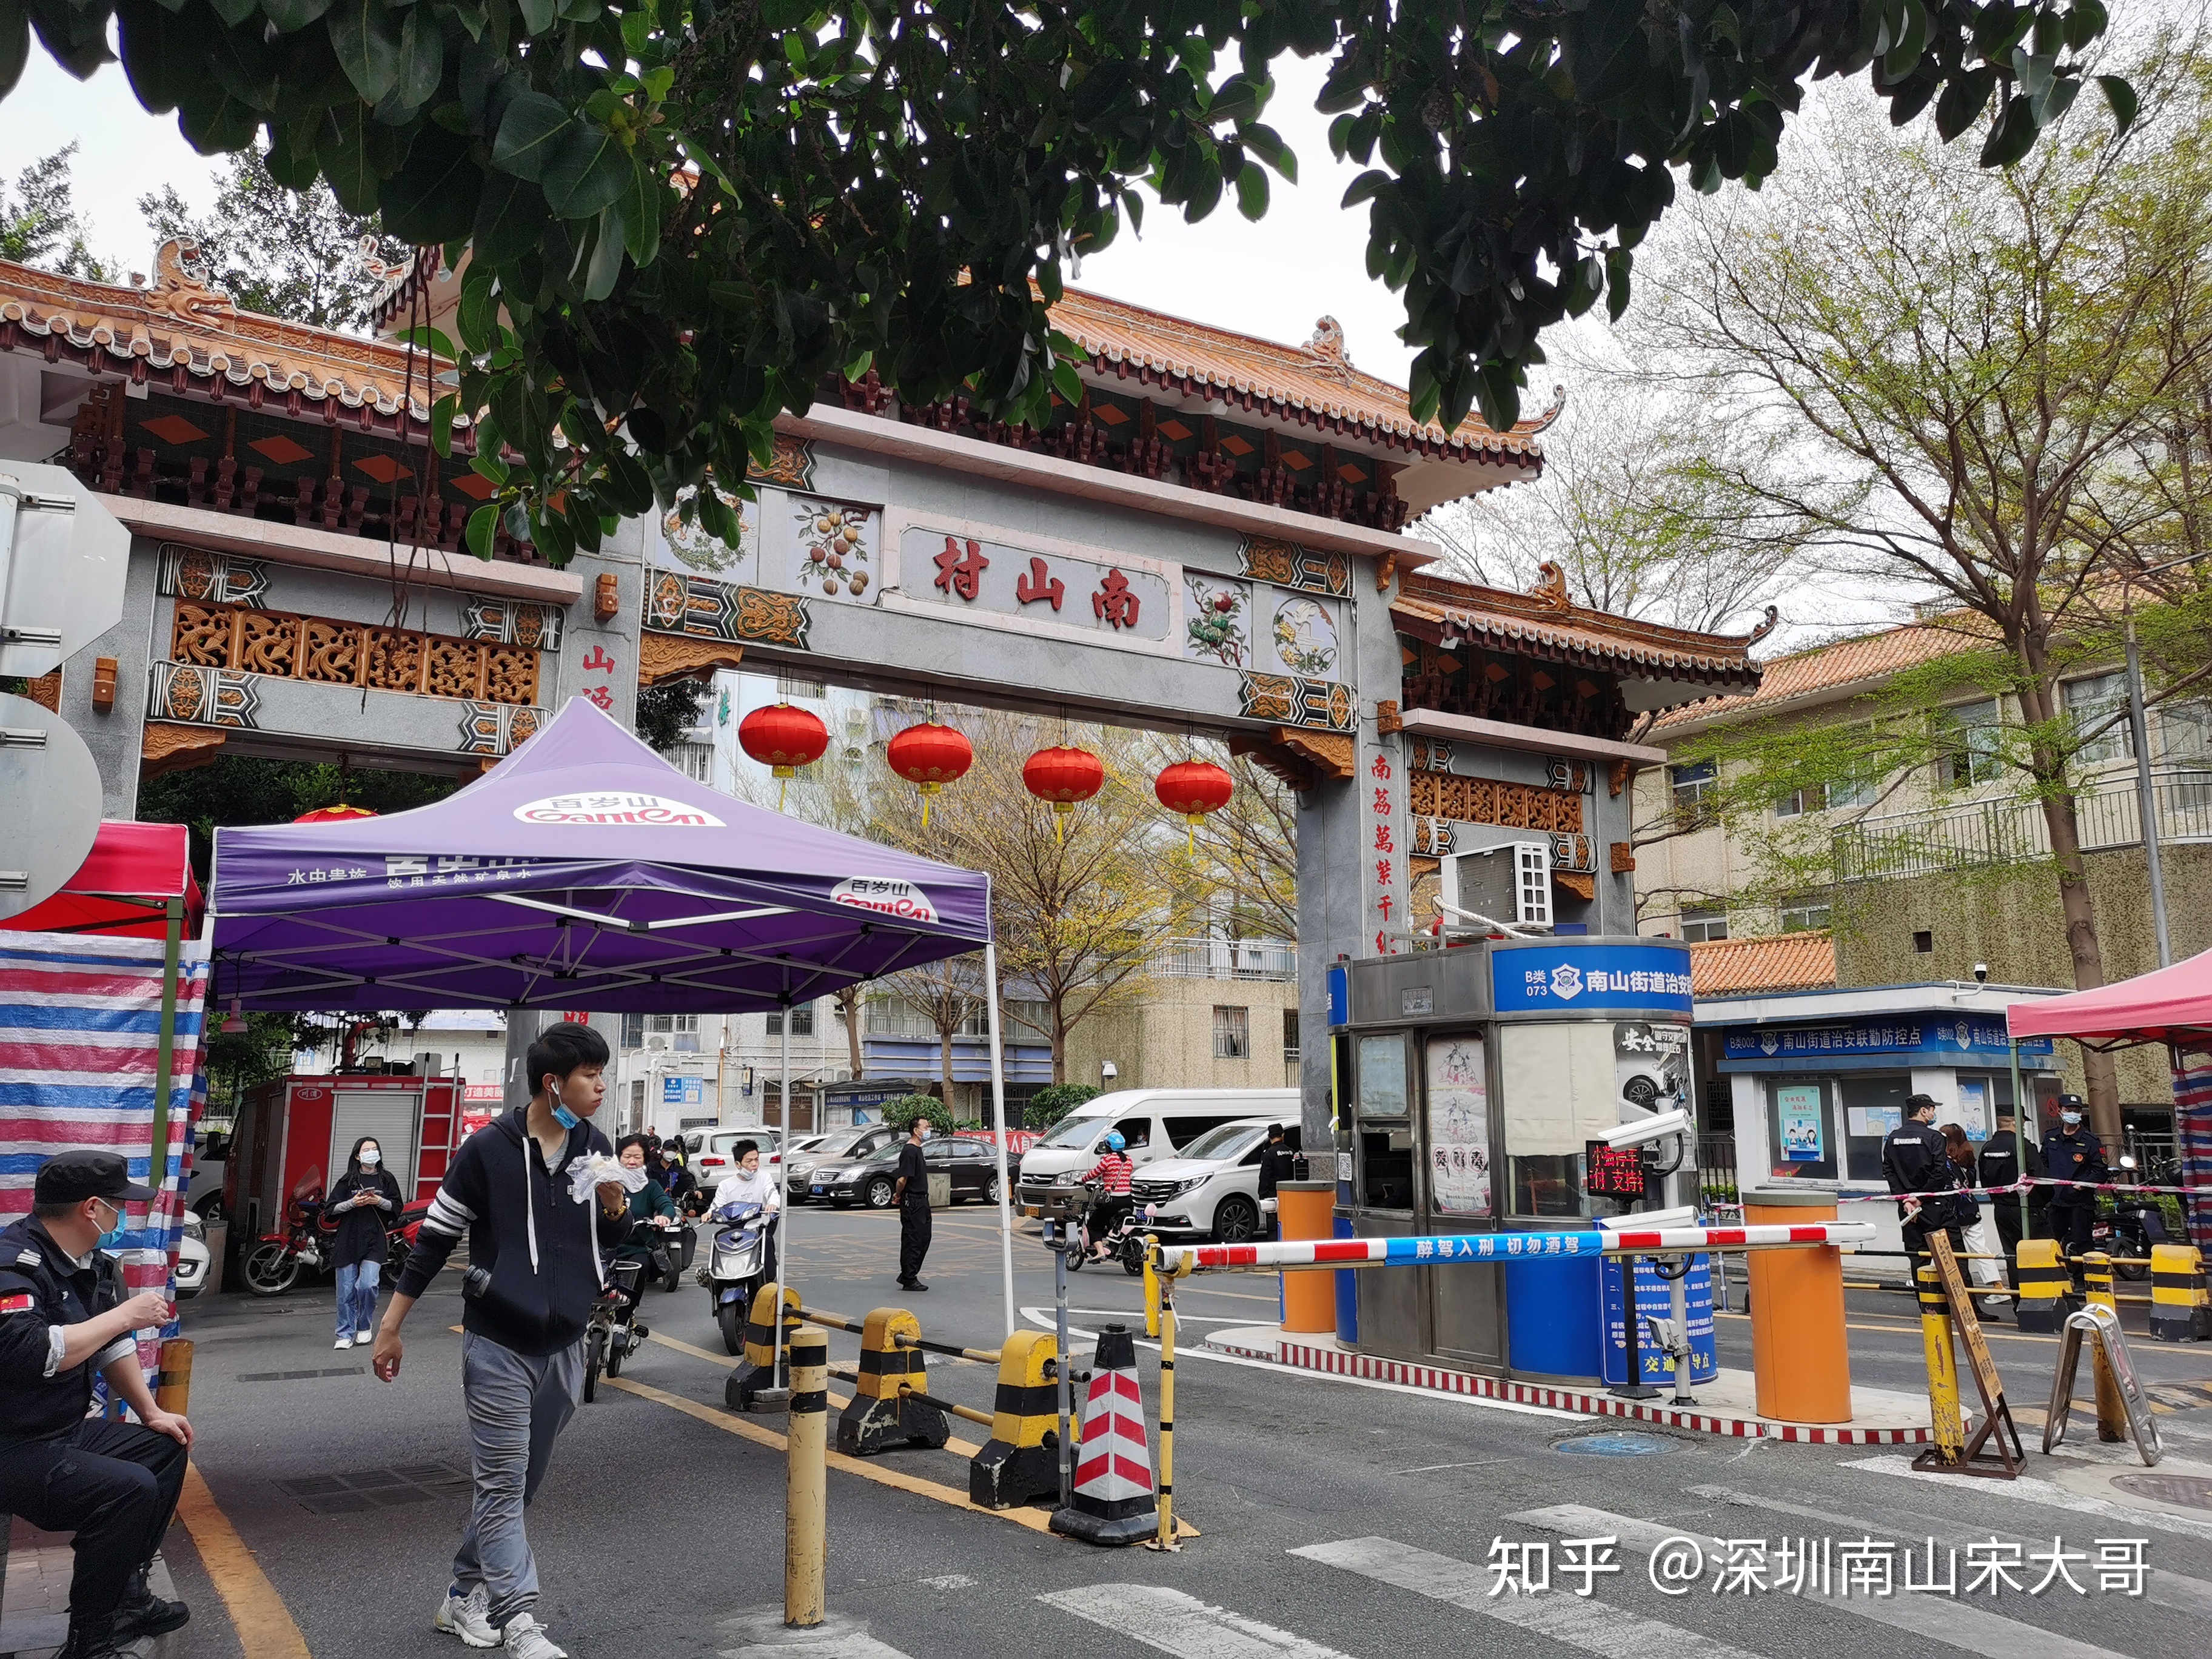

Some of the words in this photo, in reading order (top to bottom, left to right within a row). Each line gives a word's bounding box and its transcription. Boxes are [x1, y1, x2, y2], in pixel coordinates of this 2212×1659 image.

[549, 796, 659, 809] 百岁山
[525, 808, 706, 825] Ganten
[387, 868, 532, 890] 饮用天然矿泉水
[851, 879, 909, 897] 百岁山
[1525, 970, 1546, 984] B类
[1526, 986, 1547, 996] 073
[1621, 1028, 1655, 1051] 安全
[1730, 1036, 1755, 1049] B类002
[1783, 1026, 1922, 1050] 南山街道治安联勤防控点
[1415, 1238, 1494, 1259] 醉驾入刑
[1507, 1236, 1580, 1255] 切勿酒驾
